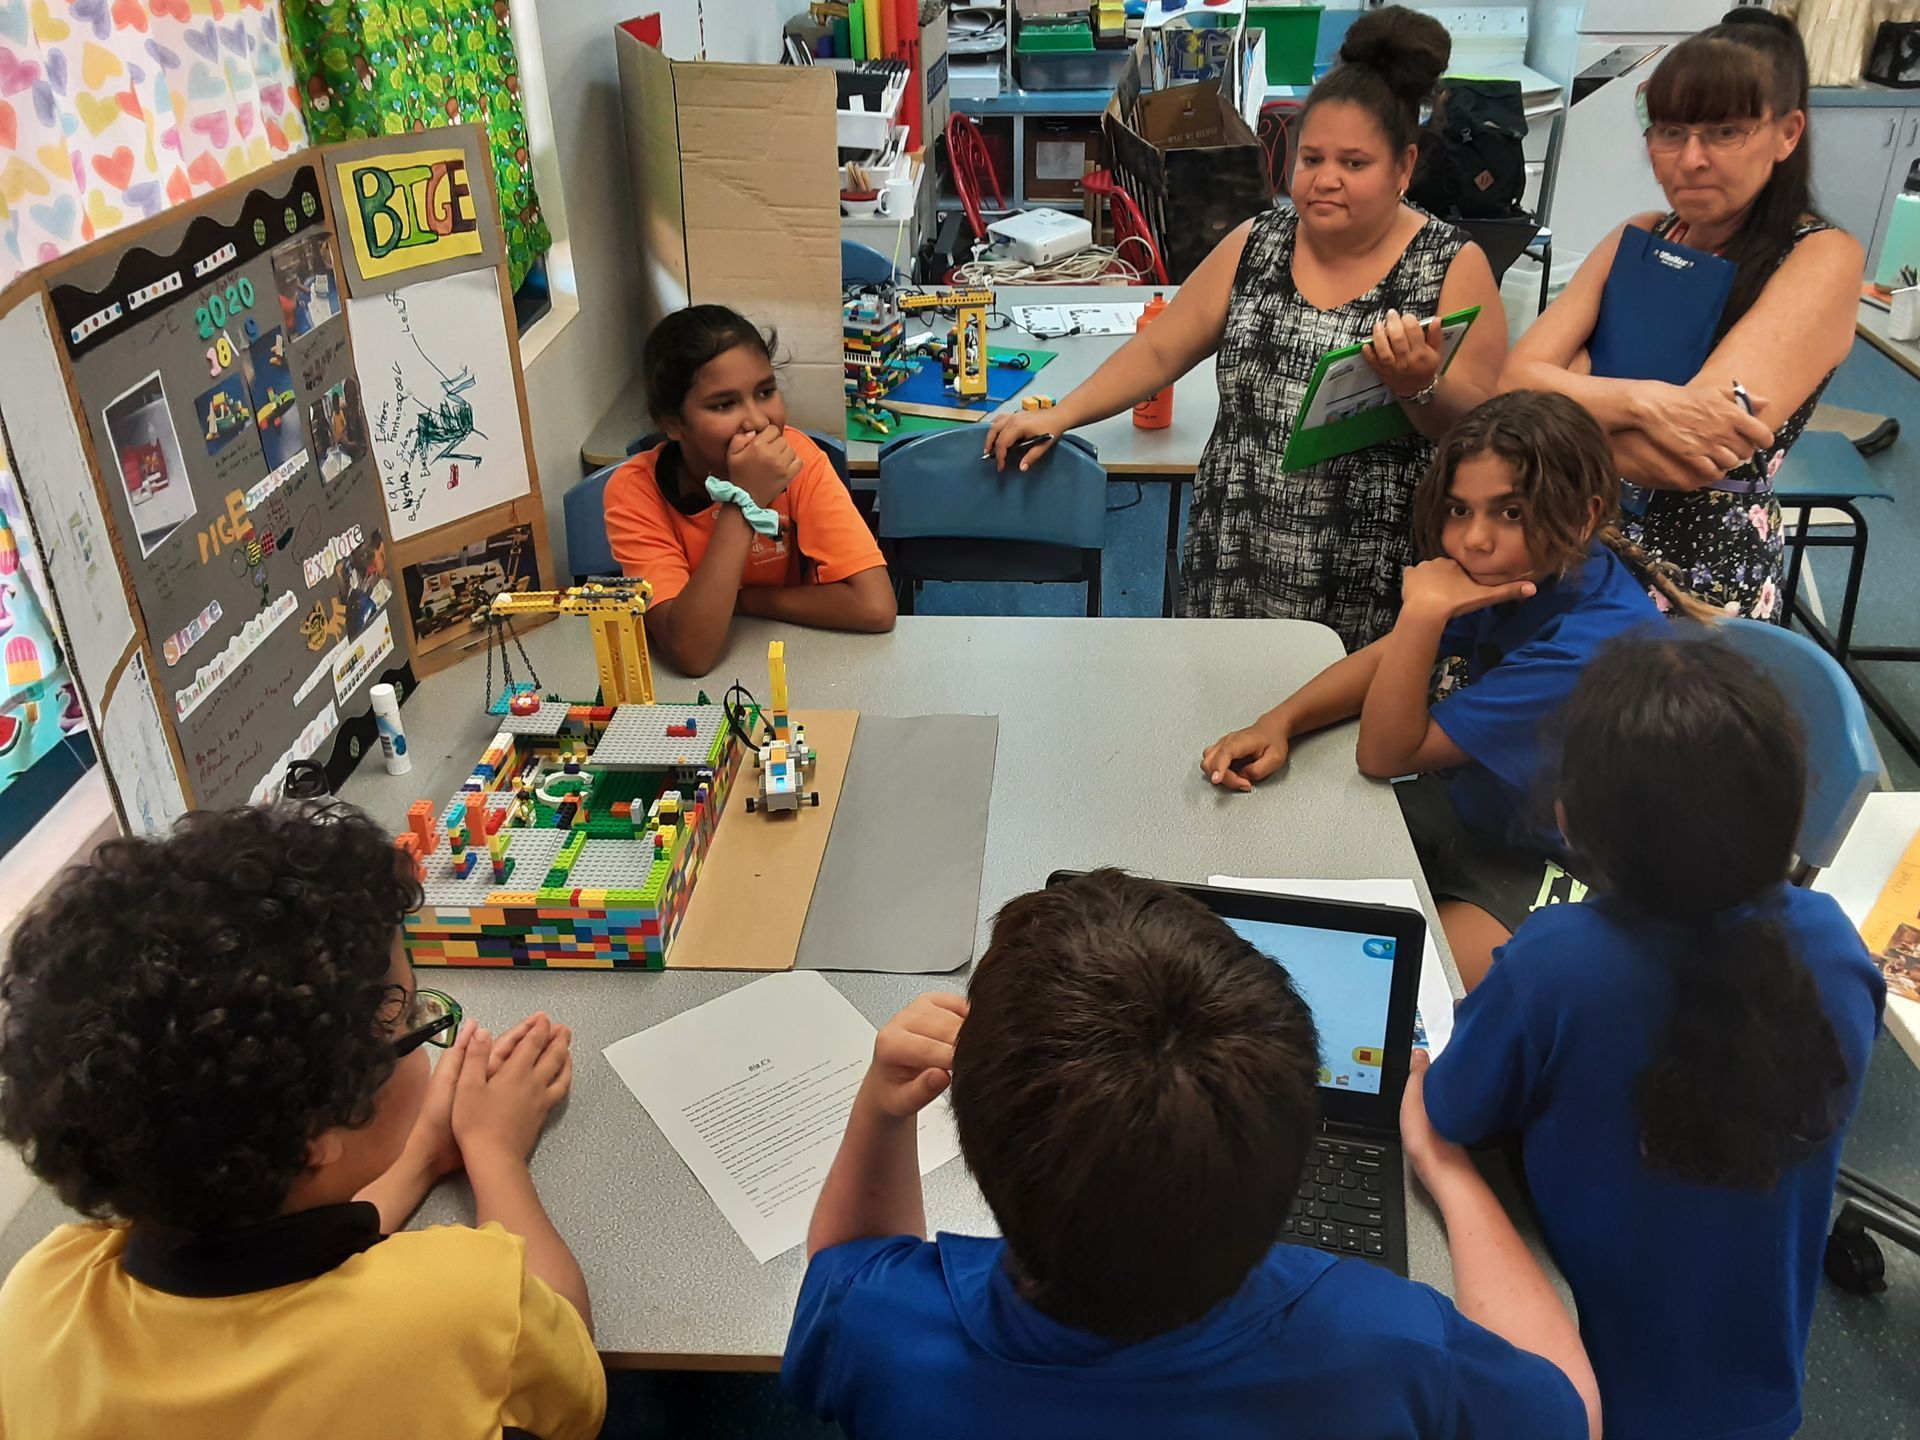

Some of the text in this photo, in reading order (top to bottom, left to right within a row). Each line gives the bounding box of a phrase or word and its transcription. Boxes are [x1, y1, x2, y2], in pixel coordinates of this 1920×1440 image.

[195, 276, 255, 340] 2020
[303, 524, 365, 586] Explore
[164, 600, 221, 664] Share
[176, 652, 235, 715] Challeng
